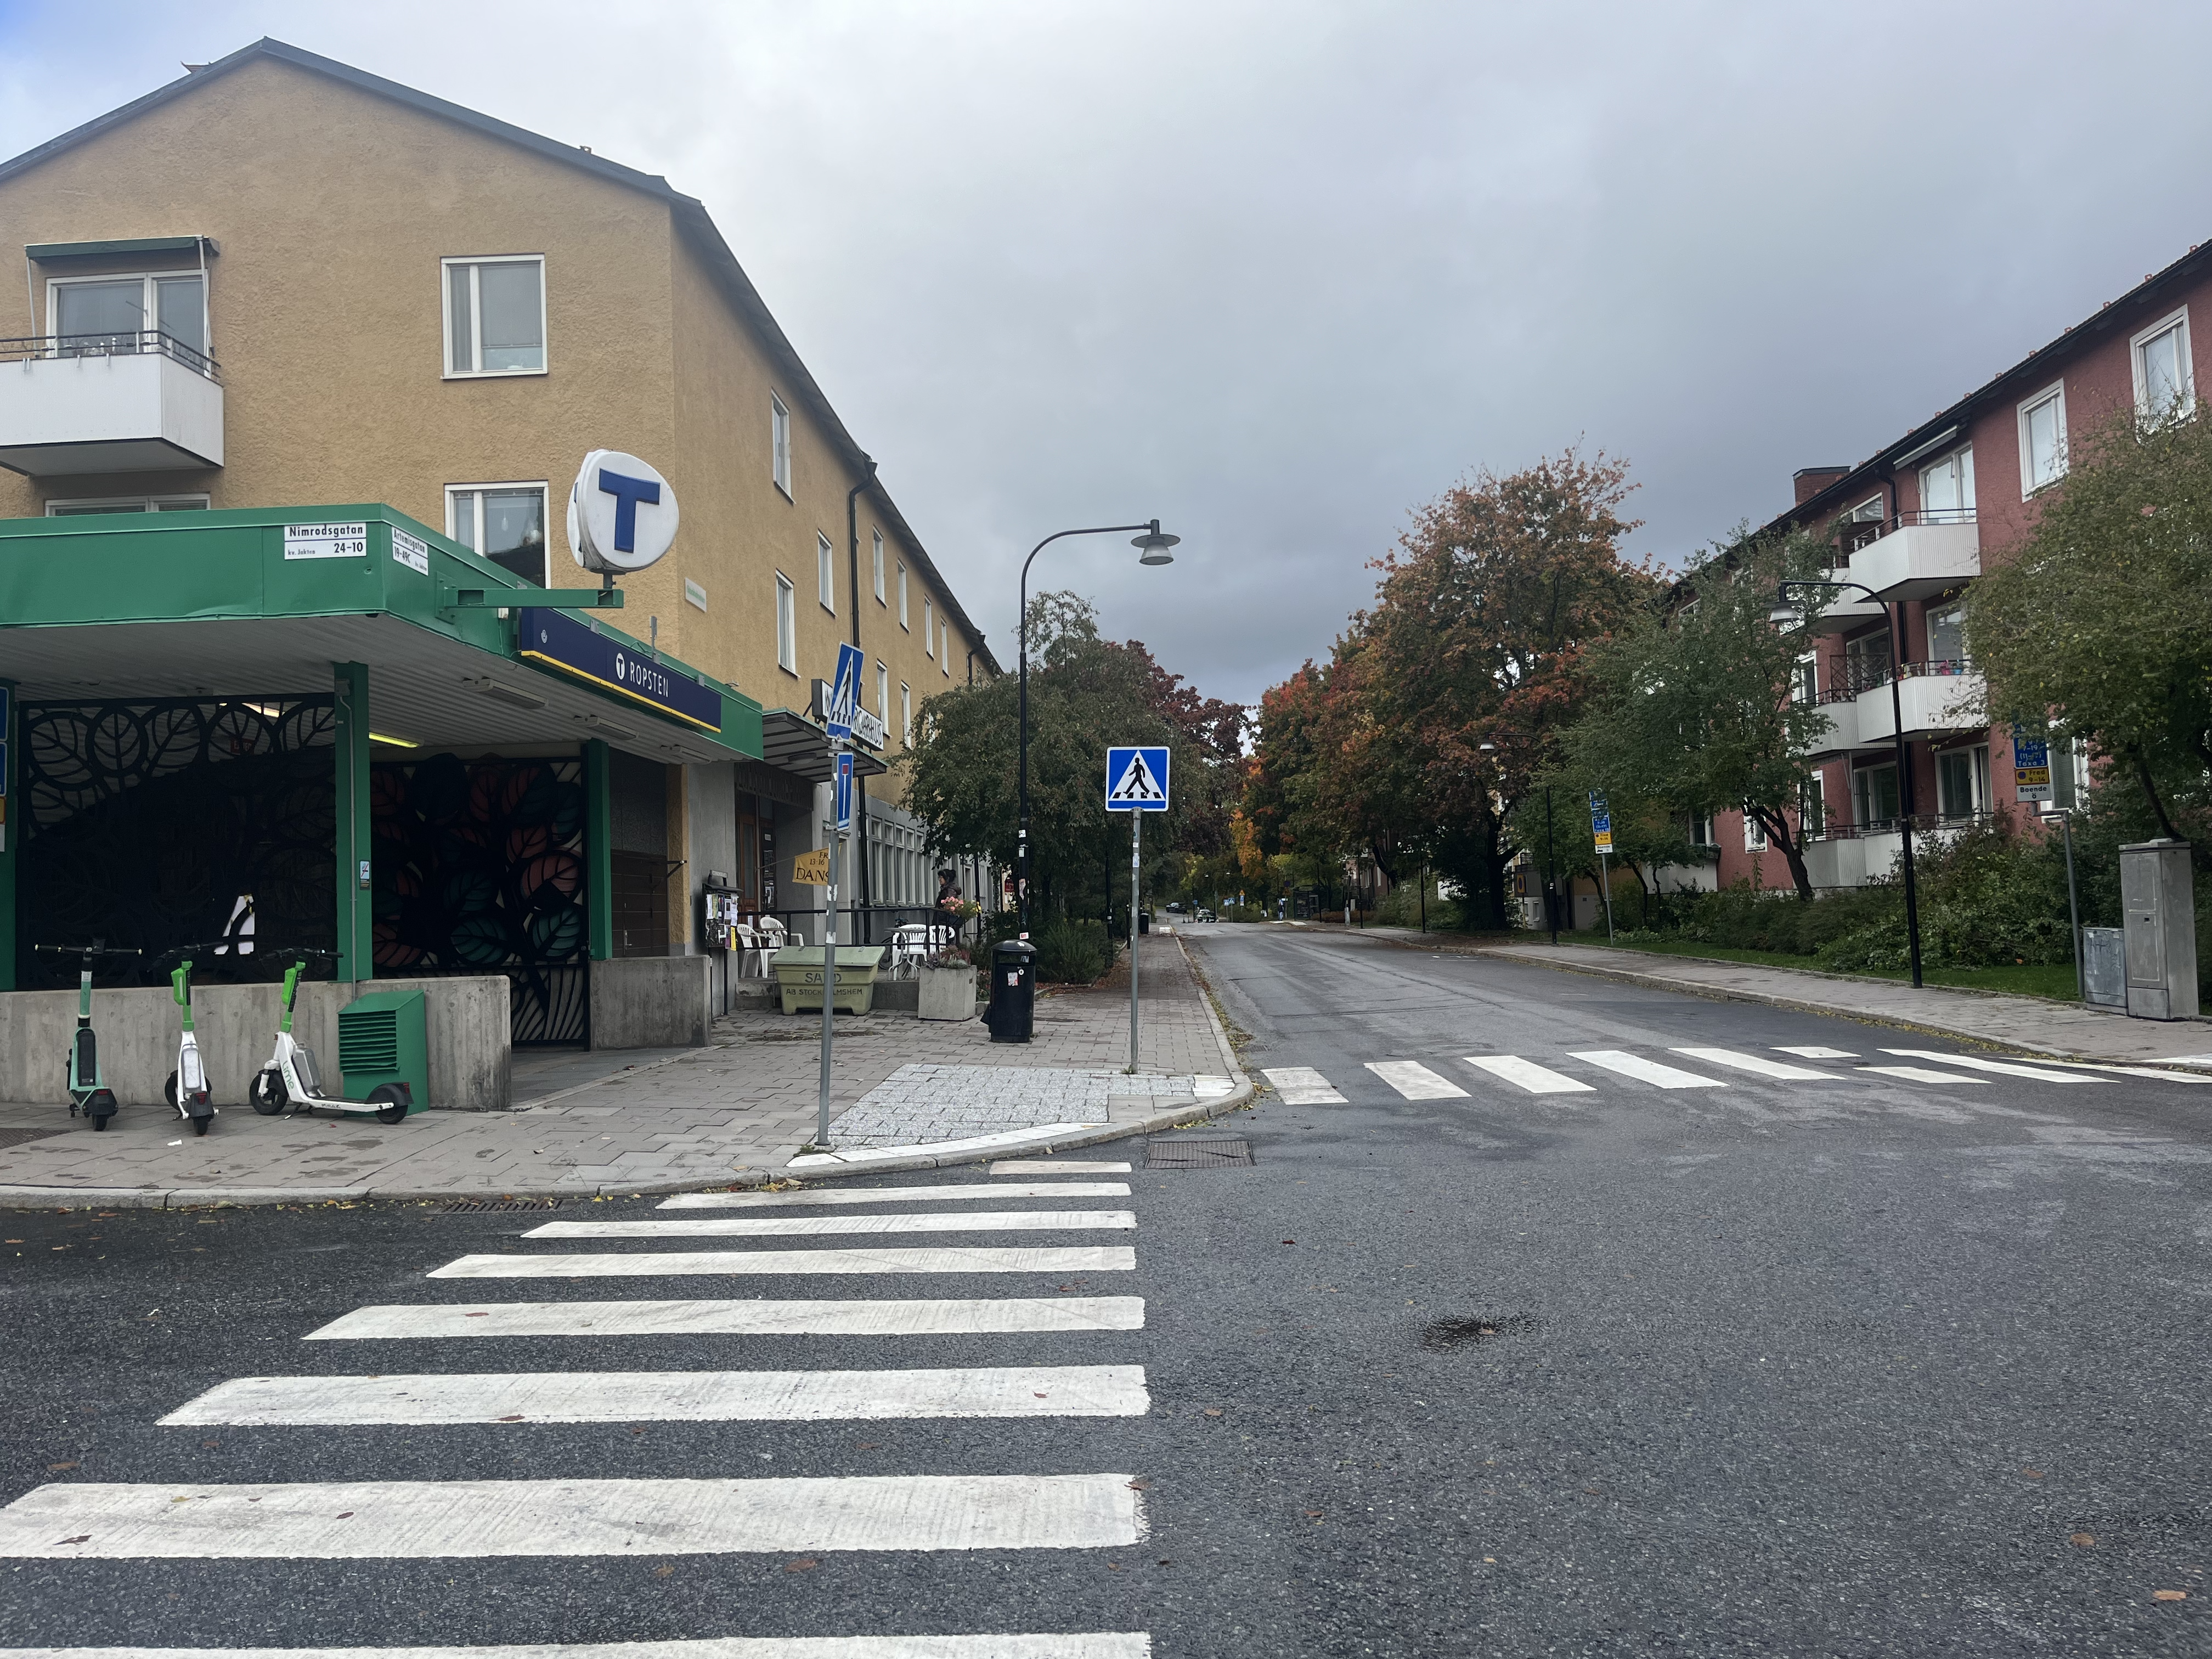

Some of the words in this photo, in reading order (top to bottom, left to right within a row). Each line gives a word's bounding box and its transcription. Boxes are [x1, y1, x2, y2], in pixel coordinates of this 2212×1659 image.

[599, 467, 661, 554] T
[289, 524, 363, 538] Nimrodsgatan
[393, 529, 426, 554] Artemisgatan
[334, 541, 363, 554] 24-10
[394, 546, 411, 563] 19-49C
[630, 661, 670, 698] ROPSTEN
[804, 973, 842, 983] SAD
[282, 1060, 295, 1090] Lime
